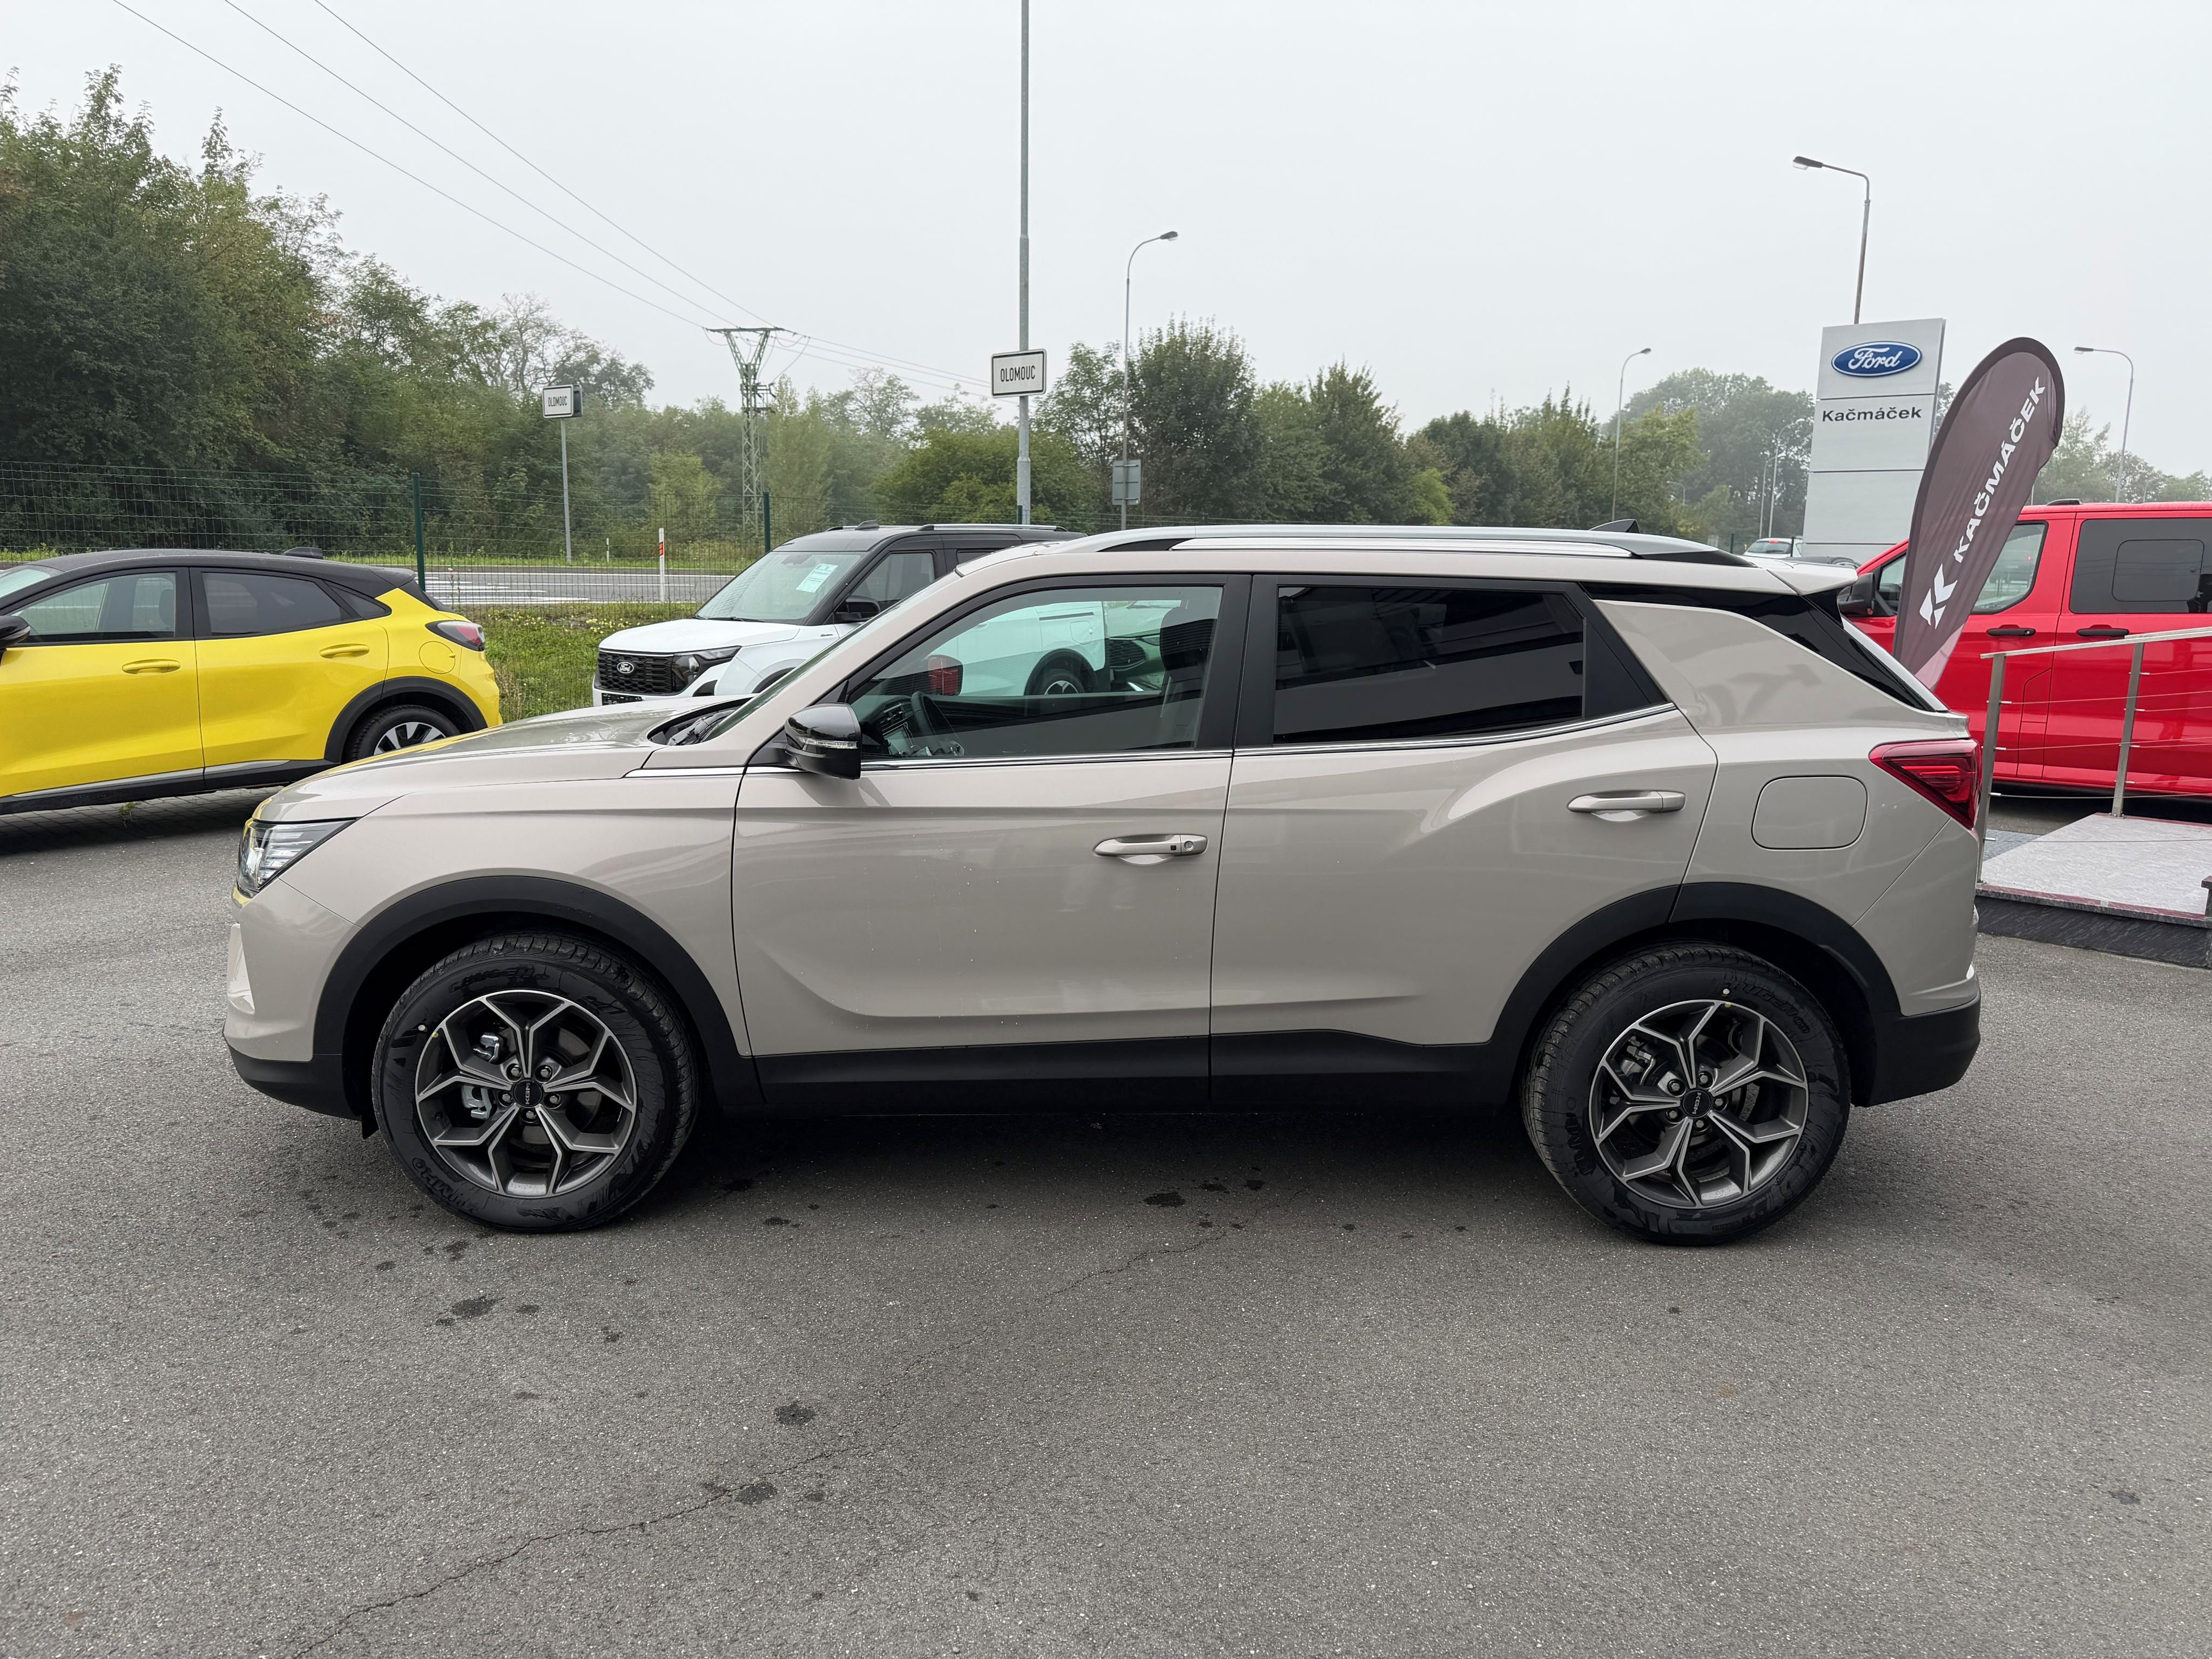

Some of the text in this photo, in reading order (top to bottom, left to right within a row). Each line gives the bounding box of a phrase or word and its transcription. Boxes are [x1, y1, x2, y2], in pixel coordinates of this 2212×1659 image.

[1848, 346, 1901, 370] Ford
[1000, 365, 1036, 382] OLOMOUC
[1822, 406, 1923, 422] Kačmáček
[1953, 376, 2046, 563] KAČMÁČEK
[1691, 1092, 1702, 1115] KGM
